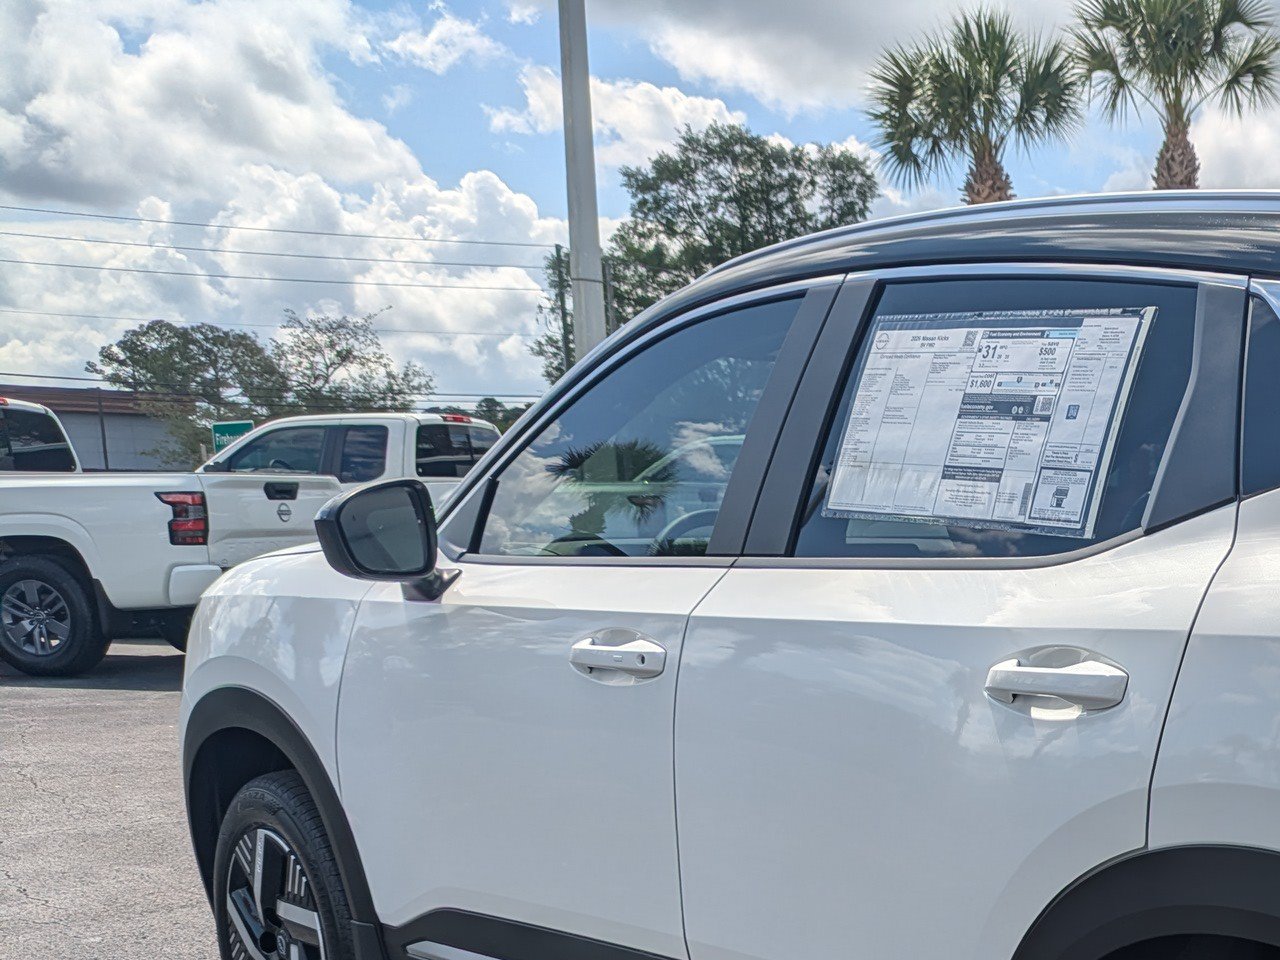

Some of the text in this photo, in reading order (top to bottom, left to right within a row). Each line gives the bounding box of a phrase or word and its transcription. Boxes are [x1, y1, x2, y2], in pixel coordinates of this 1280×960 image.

[983, 345, 997, 359] 31
[1039, 347, 1056, 356] $500
[970, 379, 991, 389] $1,600
